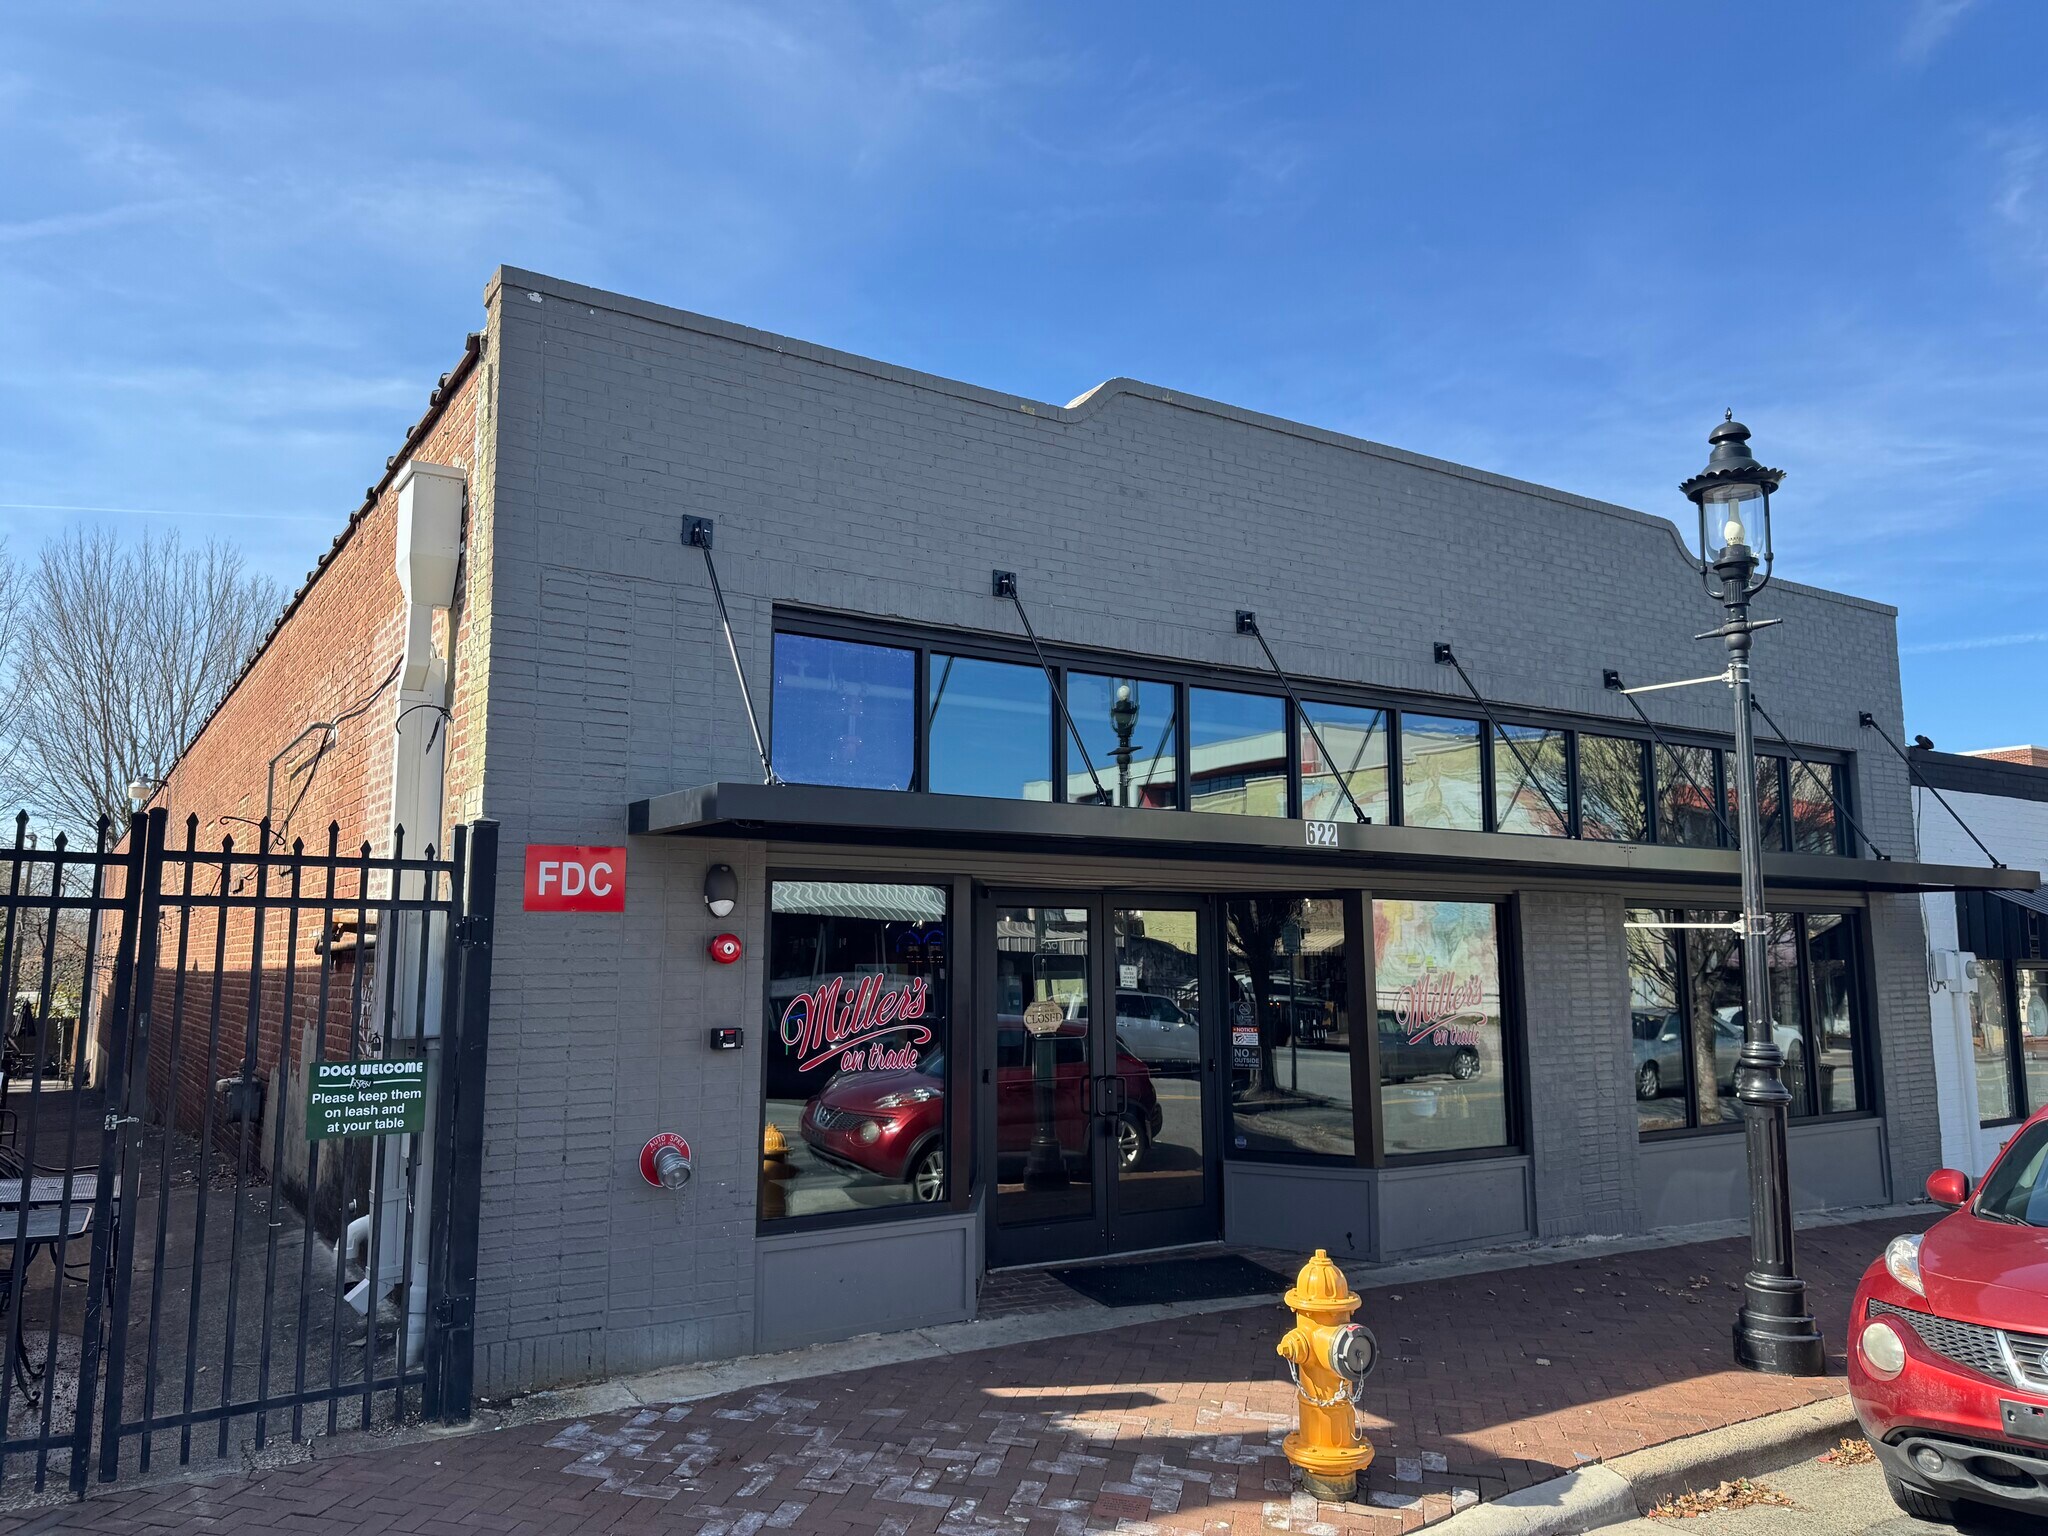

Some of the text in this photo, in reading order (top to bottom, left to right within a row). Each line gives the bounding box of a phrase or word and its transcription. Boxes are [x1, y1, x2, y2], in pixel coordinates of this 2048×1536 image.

[1307, 822, 1337, 846] 622
[538, 861, 613, 897] FDC
[1395, 971, 1483, 1036] Miller's
[780, 972, 928, 1060] Miller's
[1026, 1012, 1062, 1024] CLOSED
[1433, 1023, 1480, 1046] on trade
[841, 1040, 919, 1072] on trade
[1234, 1049, 1249, 1057] NO
[319, 1062, 423, 1077] DOGS WELCOME
[312, 1088, 422, 1105] Please keep them
[324, 1102, 405, 1119] on leash and
[327, 1117, 405, 1134] at your table
[650, 1135, 666, 1148] AUTO
[670, 1135, 685, 1148] SPKR
